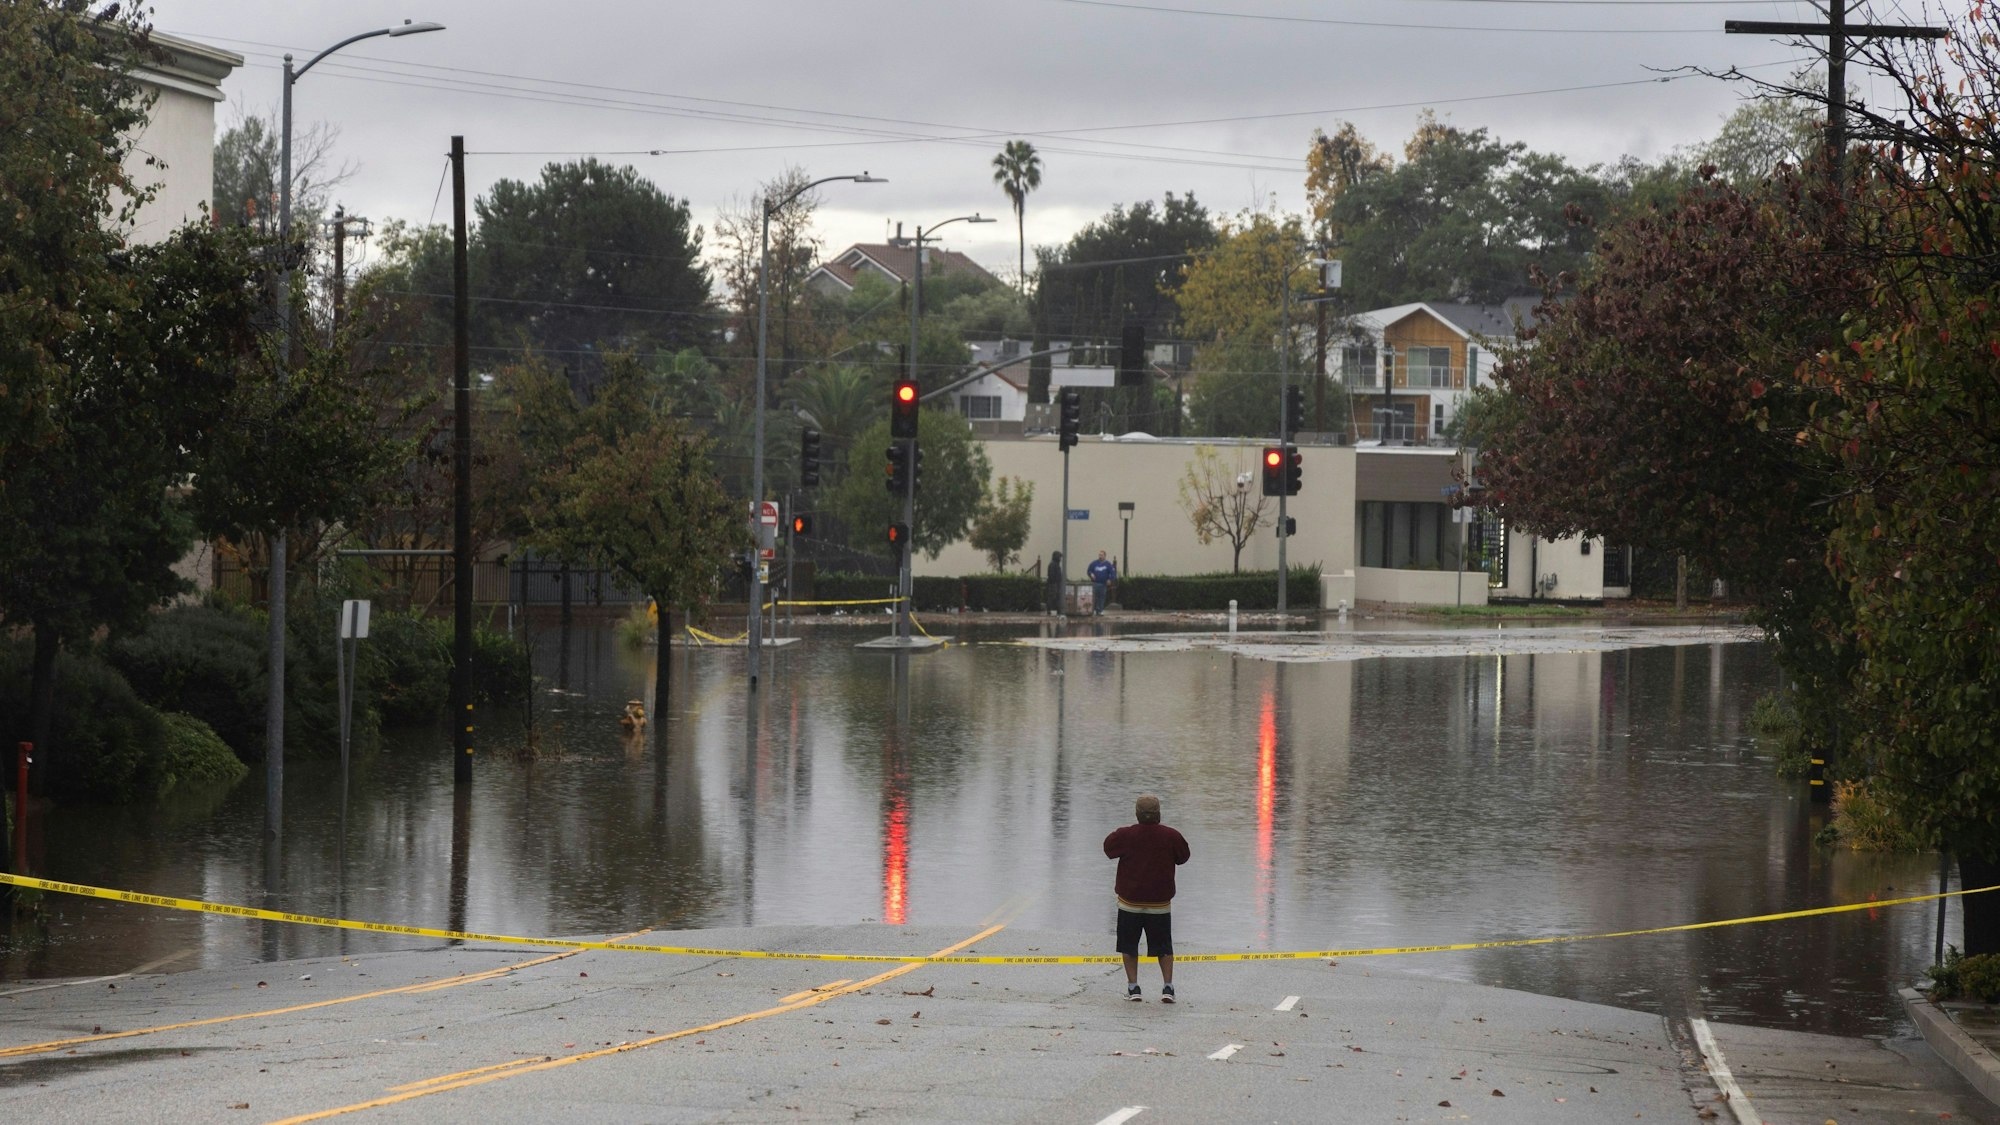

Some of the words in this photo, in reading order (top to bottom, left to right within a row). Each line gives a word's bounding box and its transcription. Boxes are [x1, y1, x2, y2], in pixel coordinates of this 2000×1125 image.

[38, 881, 48, 889] FIRE
[50, 882, 60, 890] LINE
[61, 884, 68, 892] DO
[69, 884, 80, 893] NOT
[80, 886, 96, 895] CROSS
[161, 898, 177, 906] CROSS
[242, 908, 258, 916] CROSS
